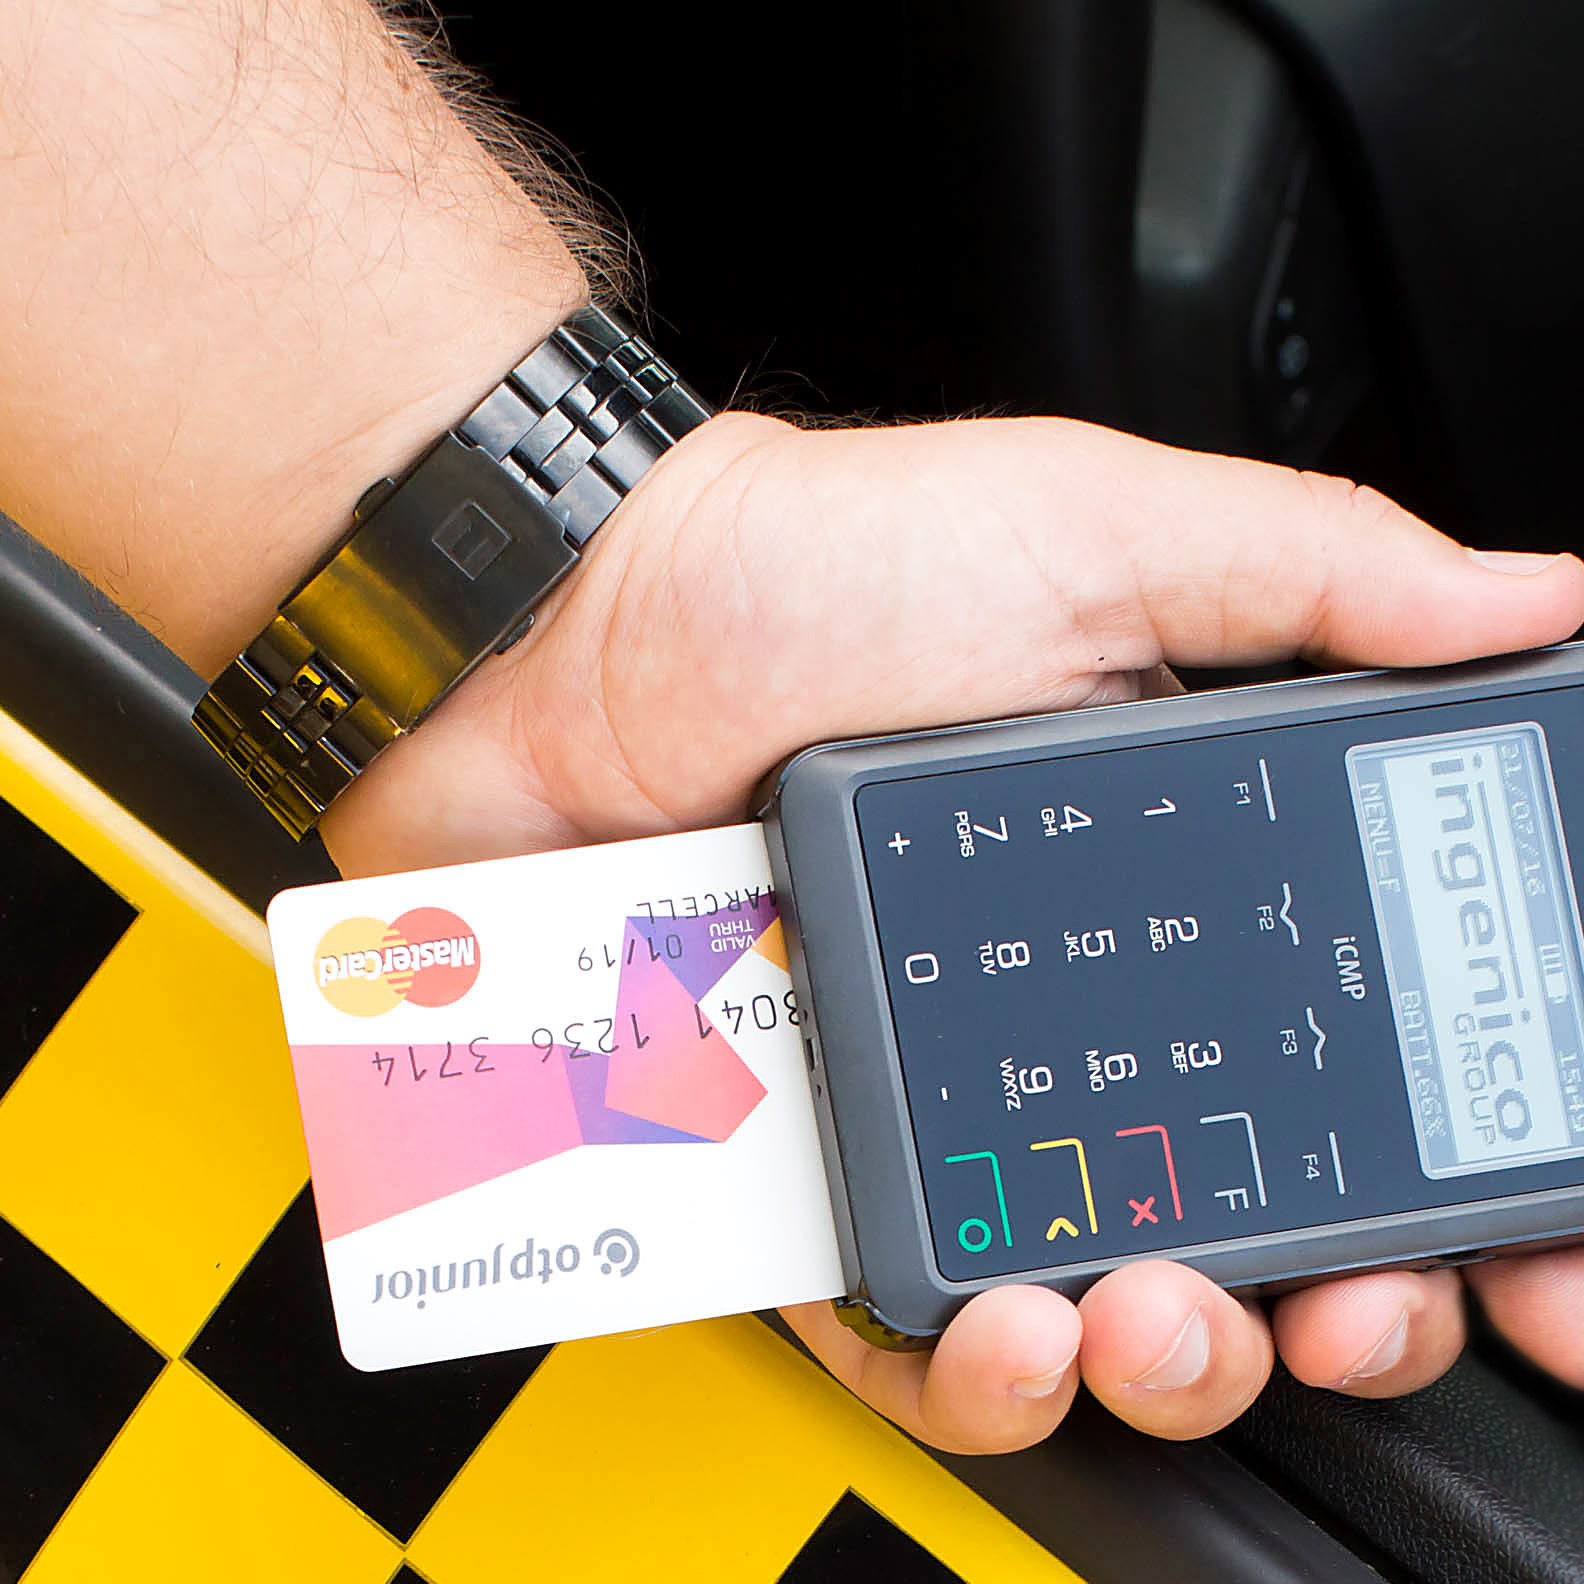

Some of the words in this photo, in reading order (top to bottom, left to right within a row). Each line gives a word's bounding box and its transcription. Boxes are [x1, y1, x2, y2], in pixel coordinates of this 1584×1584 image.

[1144, 798, 1176, 817] 1
[1233, 783, 1252, 805] F1
[974, 817, 1008, 843] 7
[1040, 808, 1058, 837] GHI
[1061, 805, 1092, 832] 4
[953, 810, 975, 858] PQRS
[709, 920, 754, 938] THRU
[1165, 917, 1199, 944] 2
[1257, 905, 1275, 931] F2
[711, 935, 756, 953] VALID
[1063, 931, 1076, 962] JKL
[1082, 929, 1116, 957] 5
[1147, 917, 1166, 952] ABC
[1430, 752, 1532, 1143] ingenico
[320, 936, 475, 985] MasterCard
[578, 934, 683, 971] 01/19
[978, 942, 996, 975] TUV
[997, 942, 1031, 969] 8
[905, 953, 940, 985] 0
[1332, 936, 1366, 1000] iCMP
[531, 1013, 650, 1062] 1236
[1280, 1029, 1298, 1055] F3
[373, 1036, 495, 1086] 3714
[1104, 1054, 1138, 1081] 6
[1170, 1042, 1189, 1074] DEF
[1189, 1041, 1222, 1068] 3
[999, 1058, 1022, 1111] WXYZ
[1018, 1066, 1054, 1093] 9
[1085, 1050, 1104, 1091] MNO
[1454, 1011, 1496, 1147] GROUP
[1302, 1153, 1320, 1180] F4
[1214, 1186, 1249, 1210] F
